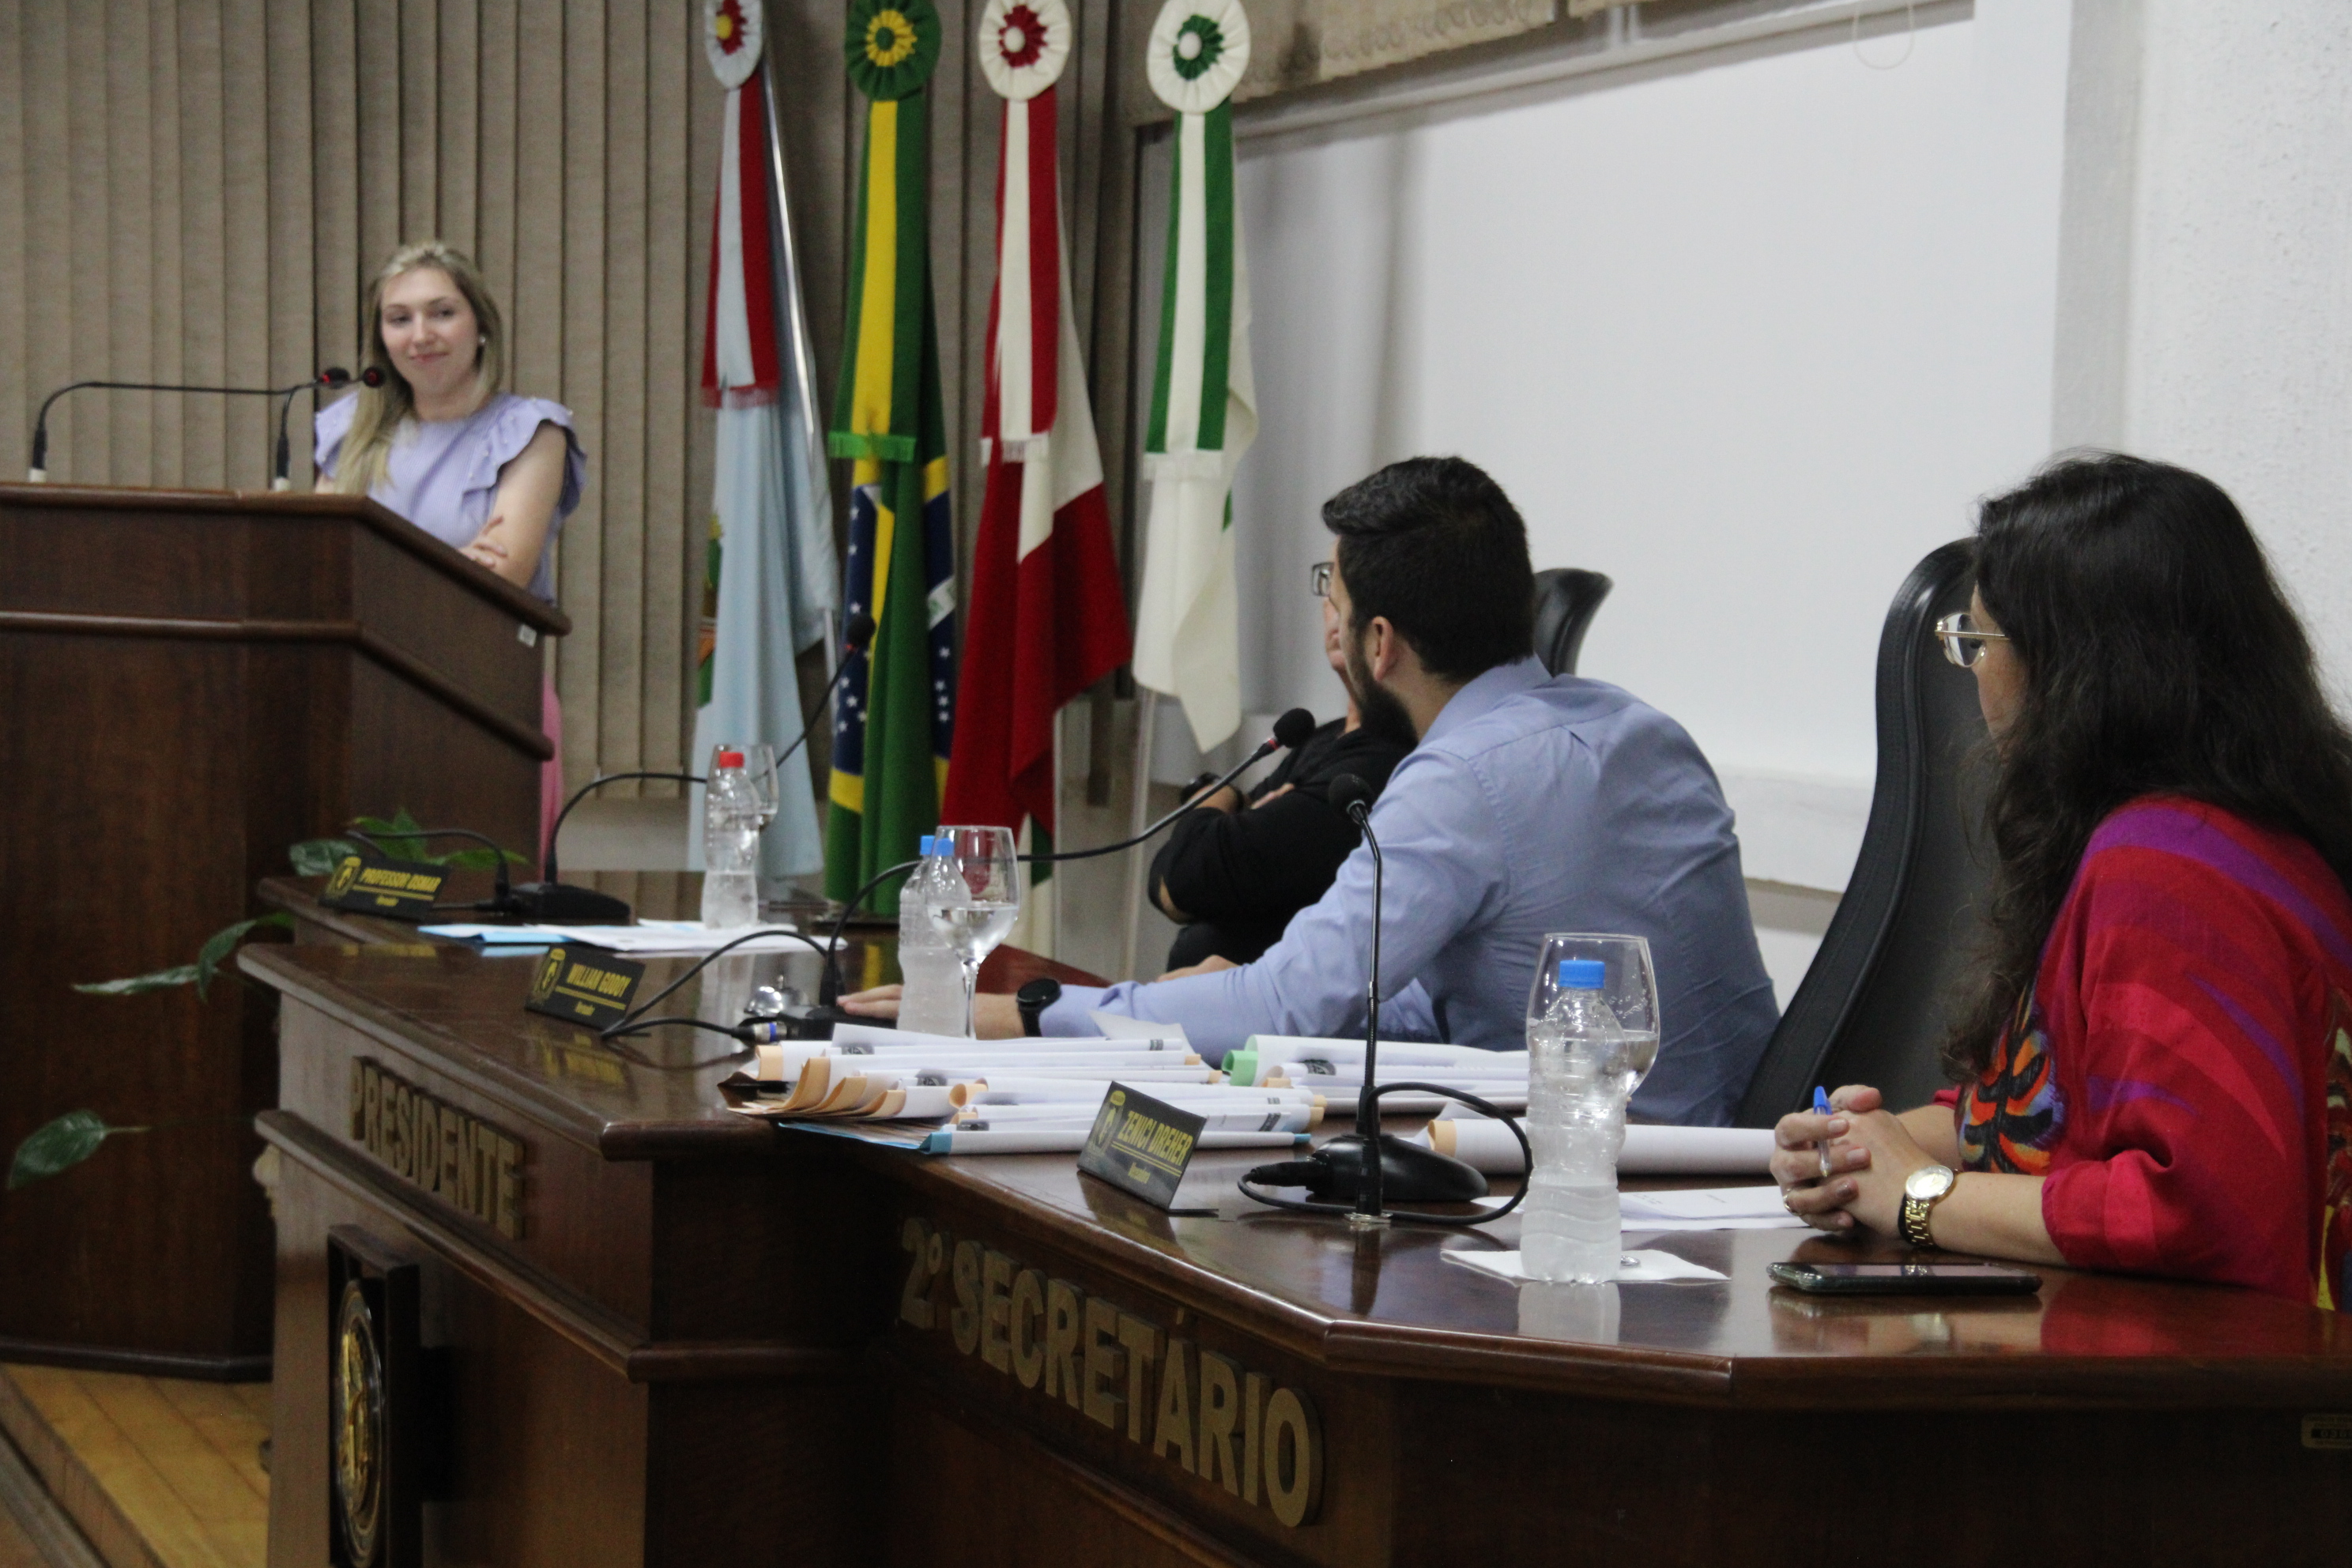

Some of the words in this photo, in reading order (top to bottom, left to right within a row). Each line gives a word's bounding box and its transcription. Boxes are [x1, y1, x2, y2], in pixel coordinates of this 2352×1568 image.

[597, 971, 631, 997] GODOY
[351, 1056, 525, 1238] PRESIDENTE
[1118, 1110, 1157, 1150] ZENICI
[1148, 1122, 1194, 1166] DREHER
[952, 1239, 1318, 1528] SECRETÁRIO
